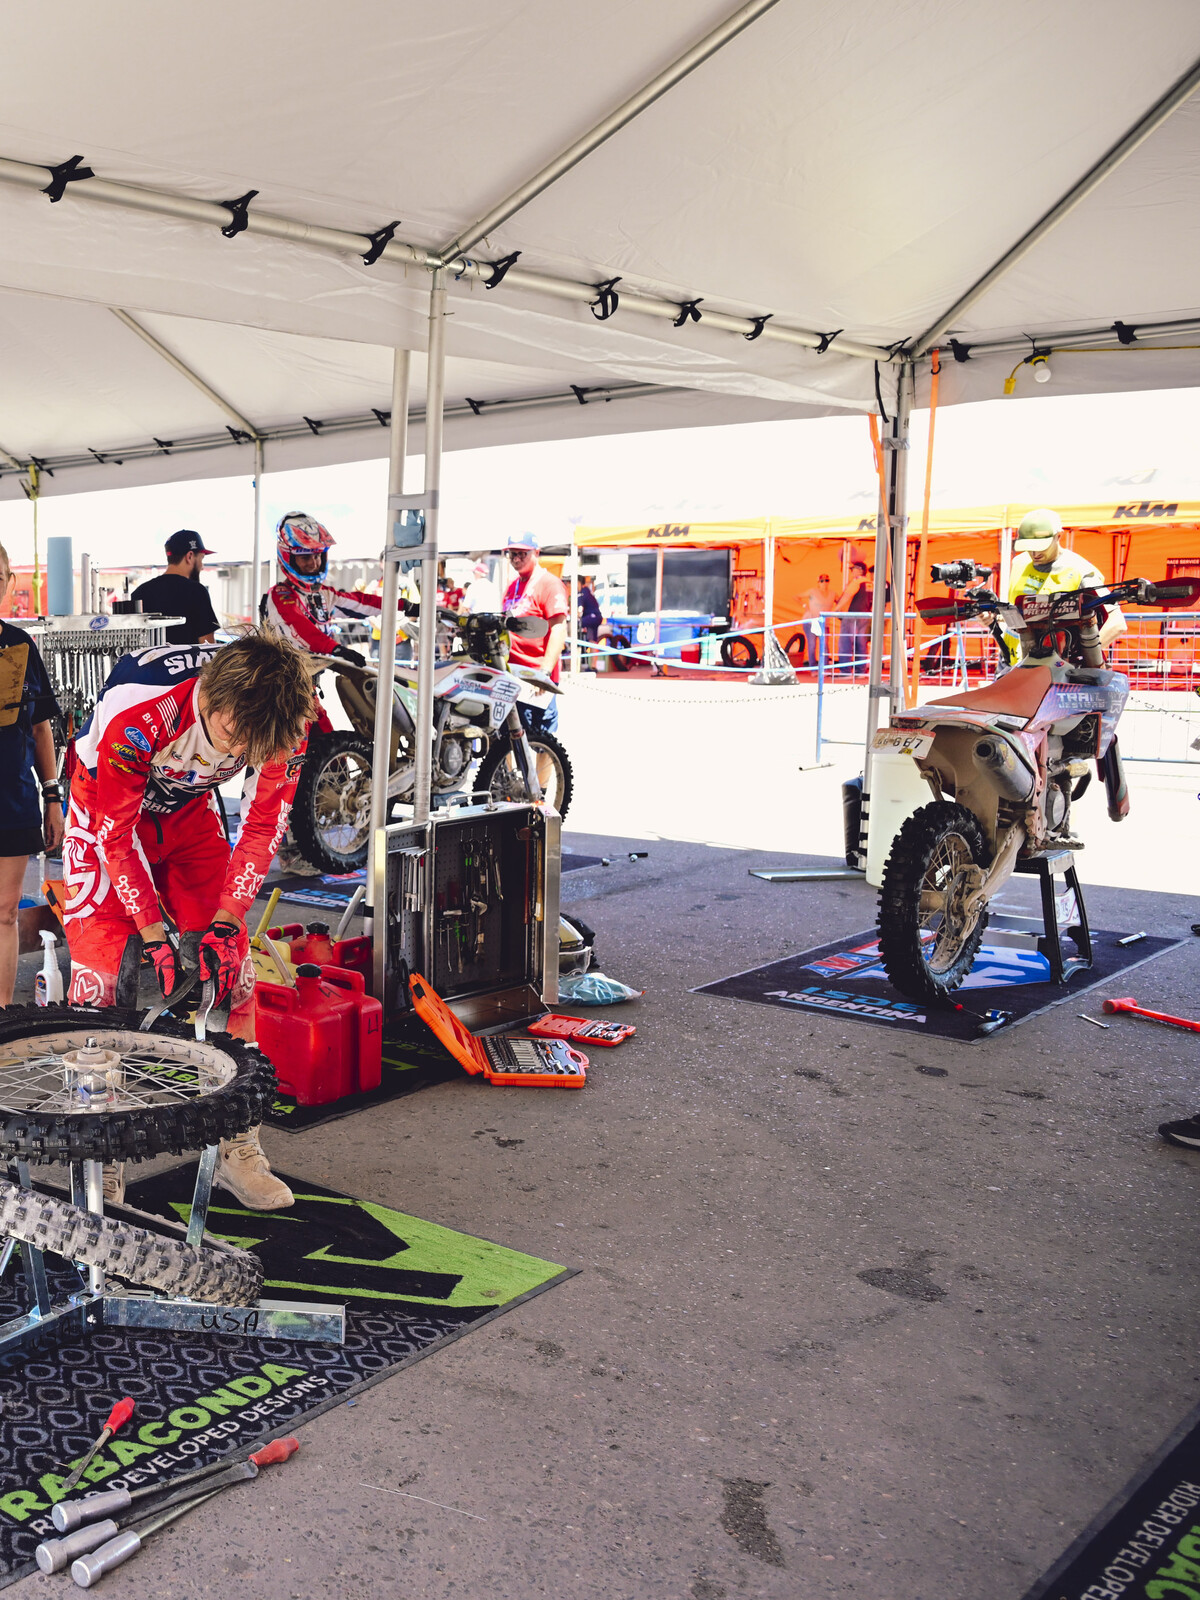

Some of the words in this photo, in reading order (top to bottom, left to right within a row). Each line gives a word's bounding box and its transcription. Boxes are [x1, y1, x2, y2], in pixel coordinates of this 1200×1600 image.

[1112, 501, 1179, 518] KTM
[646, 523, 690, 538] KTM
[1056, 692, 1105, 702] TRAIL
[762, 990, 928, 1024] ARGENTINA
[200, 1309, 260, 1334] USA
[105, 1420, 241, 1491] DEVELOPED
[237, 1374, 329, 1424] DESIGNS
